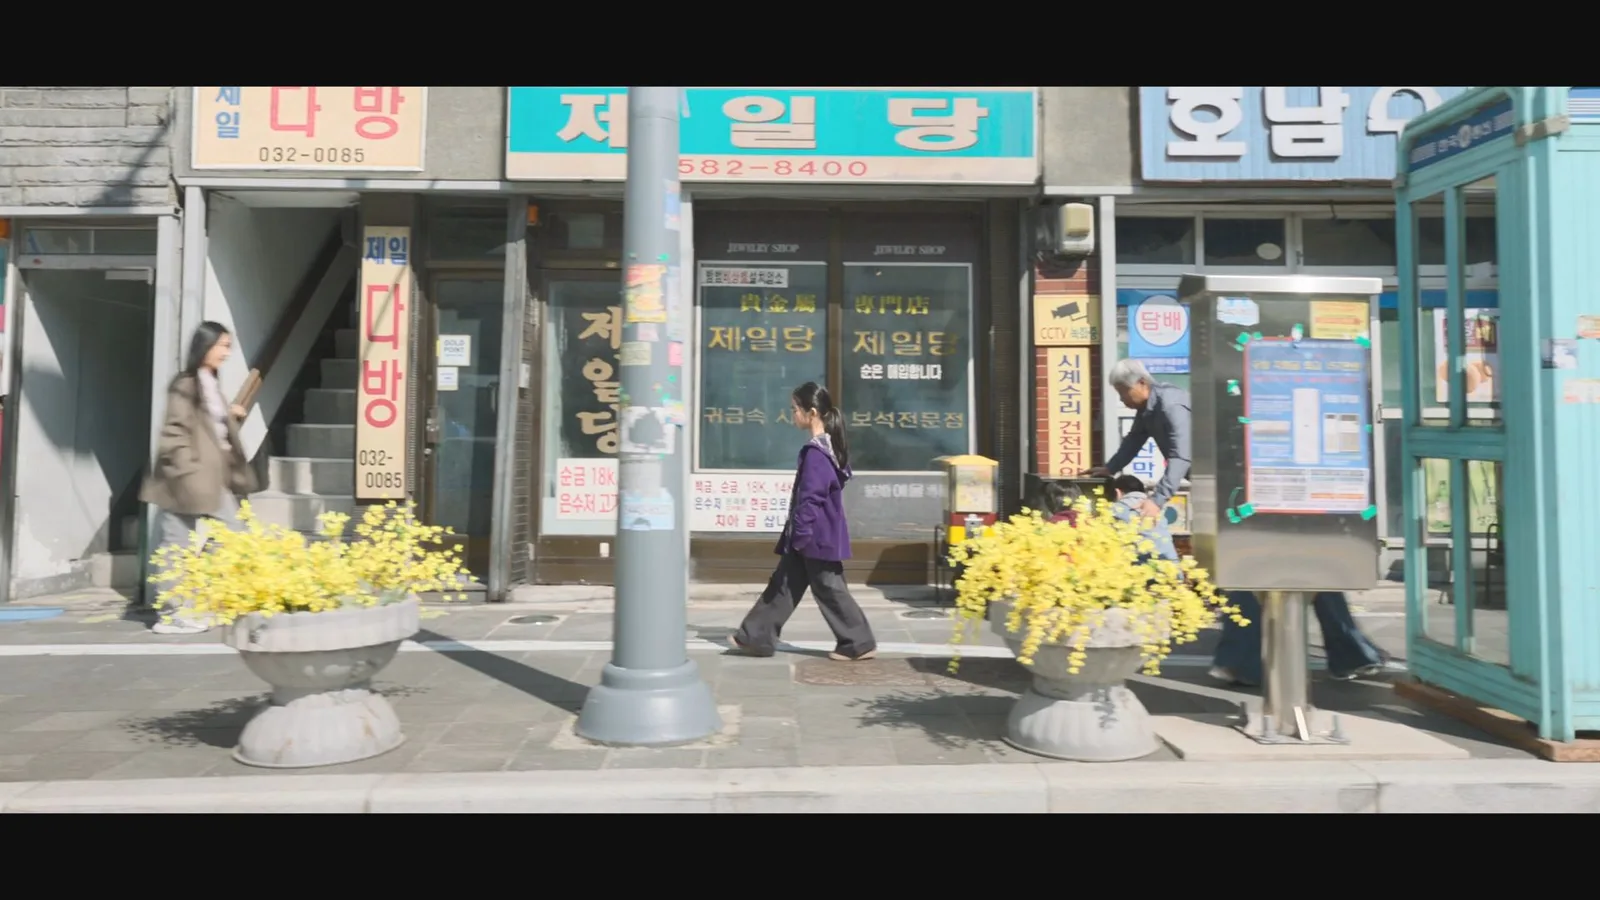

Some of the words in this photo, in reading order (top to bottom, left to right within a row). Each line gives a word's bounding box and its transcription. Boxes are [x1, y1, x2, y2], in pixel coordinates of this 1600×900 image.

[215, 86, 241, 138] 제일
[270, 86, 405, 140] 다방
[259, 147, 365, 162] 032-0085
[678, 158, 868, 176] 582-8400
[365, 235, 407, 265] 제일
[727, 242, 770, 254] JEWELRY
[772, 243, 800, 253] SHOP
[874, 245, 917, 255] JEWELRY
[919, 245, 946, 255] SHOP
[1141, 311, 1182, 331] 담배
[707, 326, 816, 352] 제일당
[1040, 327, 1067, 340] CCTV
[852, 331, 958, 356] 제일당
[362, 283, 404, 428] 다방
[860, 364, 884, 379] 순은
[1058, 354, 1083, 416] 시계수리
[703, 407, 766, 425] 귀금속
[850, 411, 964, 429] 보석전문점
[359, 450, 393, 466] 032-
[365, 472, 402, 488] 0085
[560, 466, 586, 487] 순금
[560, 493, 596, 514] 은수저
[746, 515, 756, 528] 금
